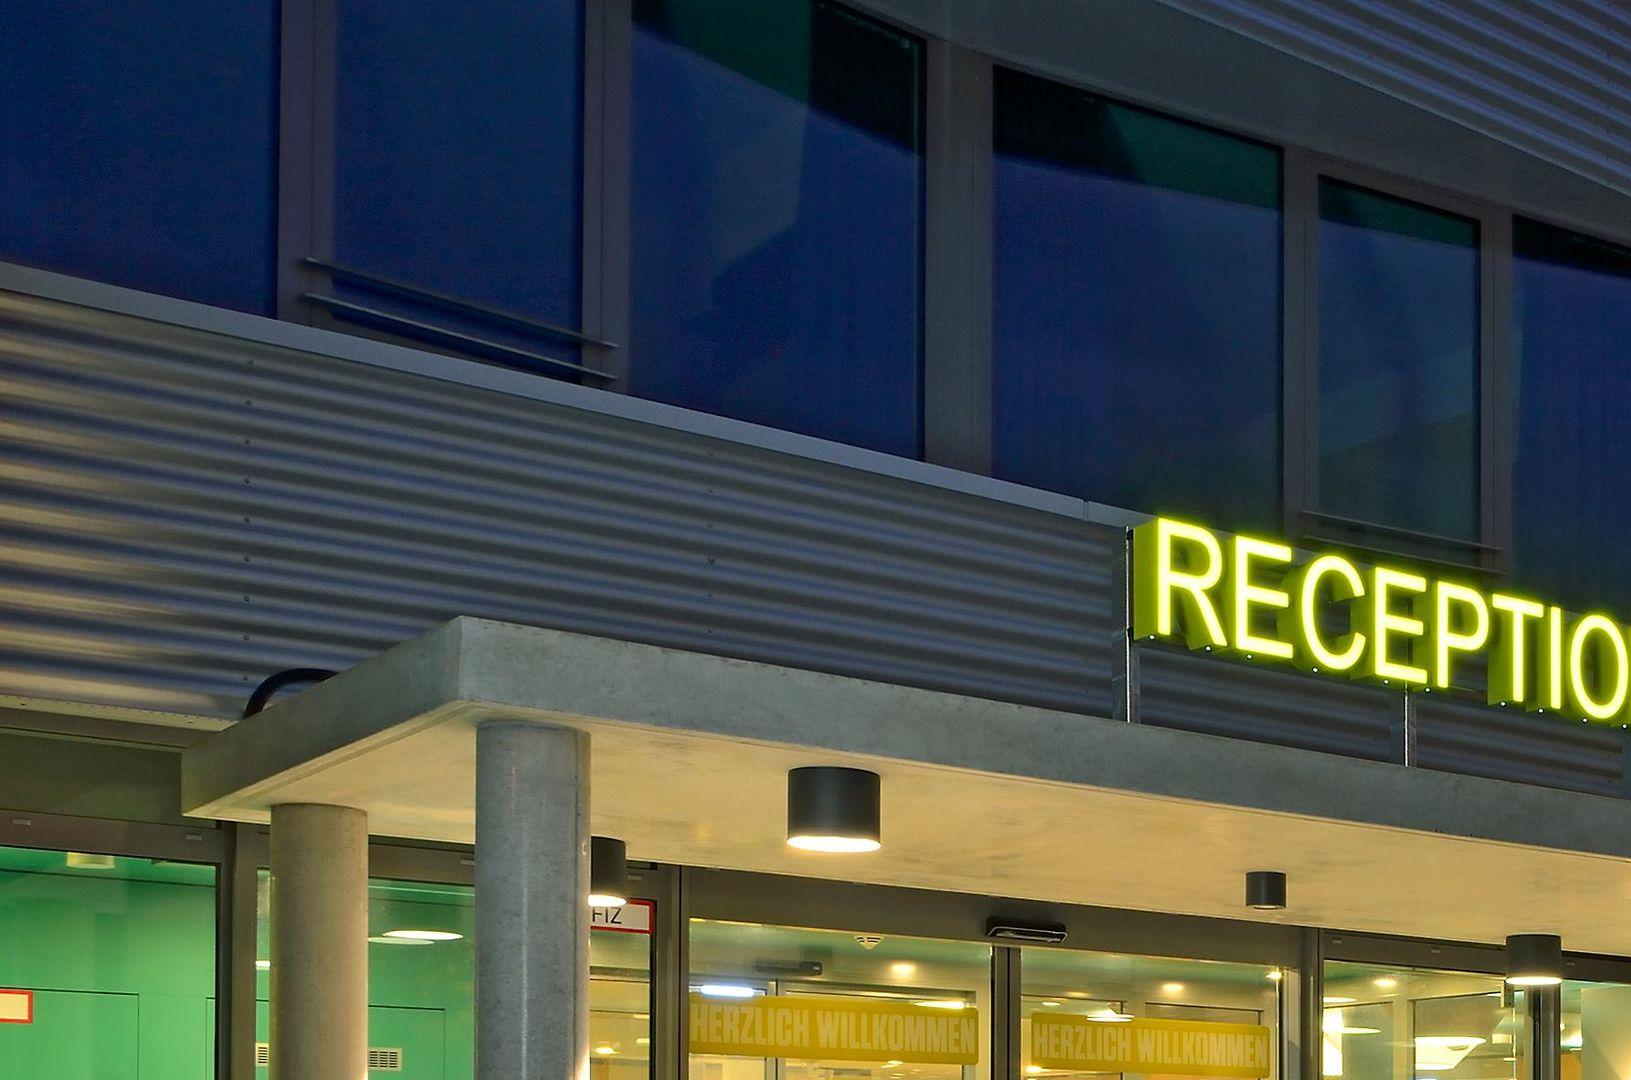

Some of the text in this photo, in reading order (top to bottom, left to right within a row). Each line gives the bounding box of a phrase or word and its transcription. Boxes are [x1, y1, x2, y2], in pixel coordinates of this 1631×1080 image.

[691, 1002, 976, 1055] HERZLICH WILLKOMMEN
[1033, 1022, 1268, 1068] HERZLICH WILLKOMMEN
